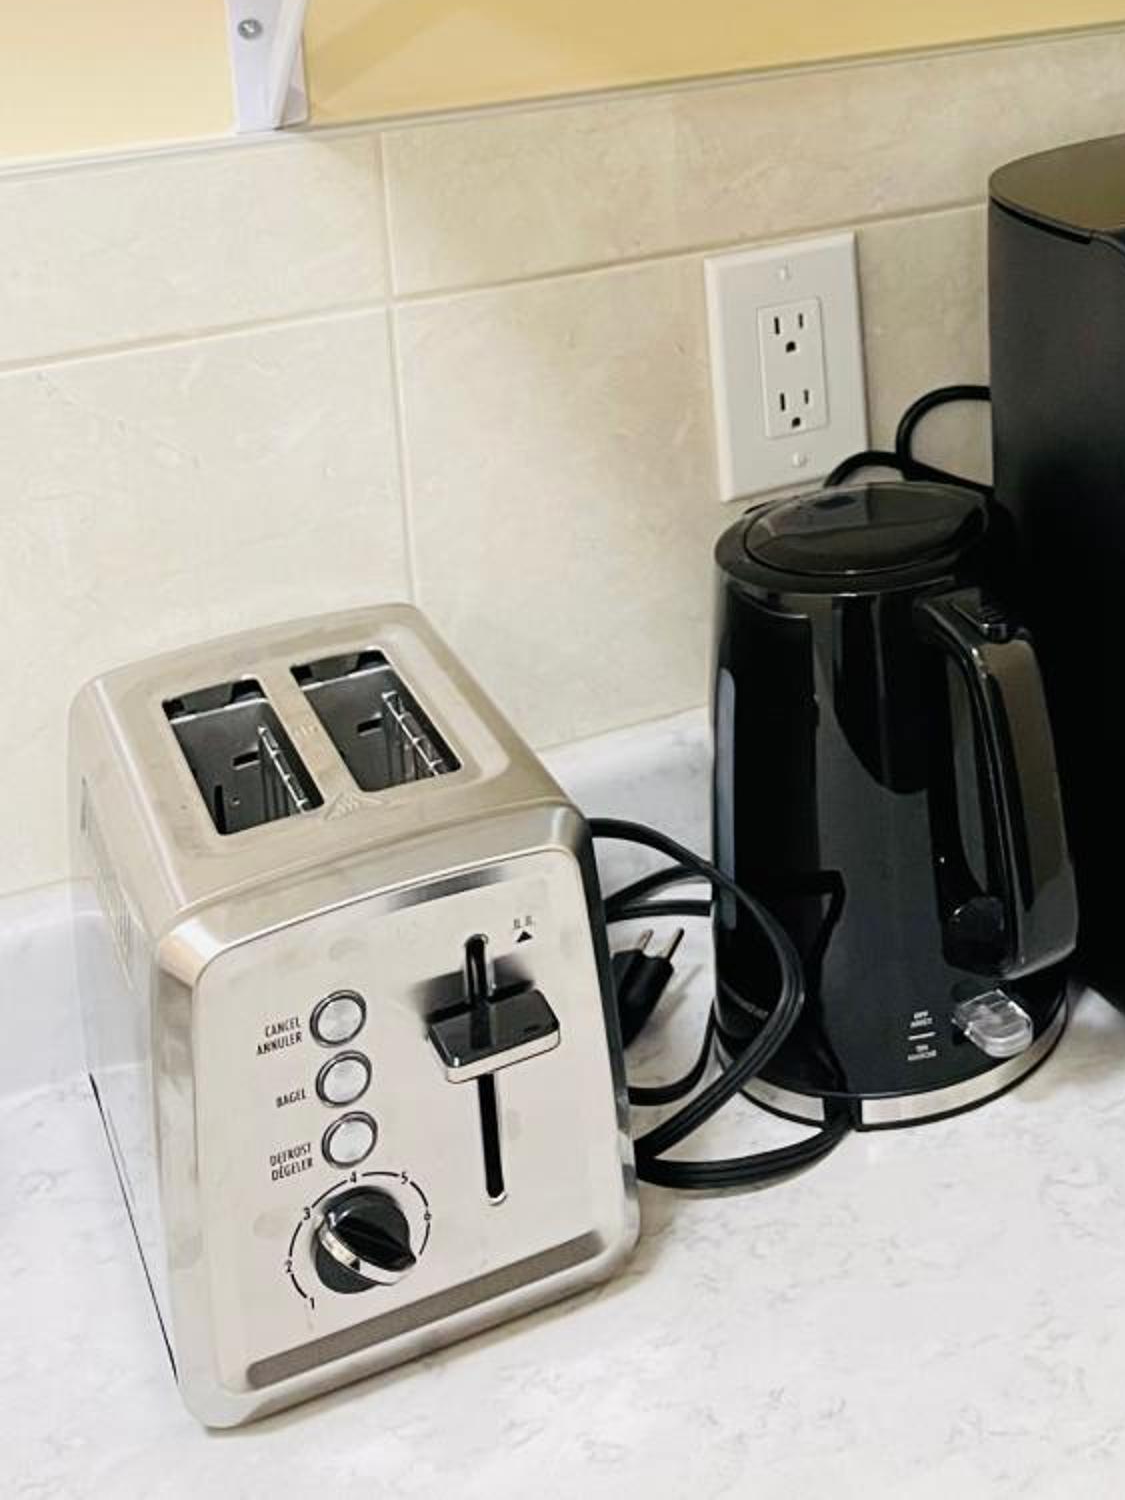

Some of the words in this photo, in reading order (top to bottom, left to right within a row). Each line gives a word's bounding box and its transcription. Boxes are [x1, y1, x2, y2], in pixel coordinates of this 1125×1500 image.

[264, 1016, 301, 1038] CANCEL
[256, 1031, 302, 1056] ANNULER
[275, 1088, 306, 1108] BAGEL
[269, 1142, 312, 1167] DEFROST
[349, 1171, 358, 1184] 4
[400, 1171, 409, 1185] 5
[303, 1207, 311, 1221] 3
[284, 1261, 293, 1273] 2
[309, 1297, 316, 1310] 1
